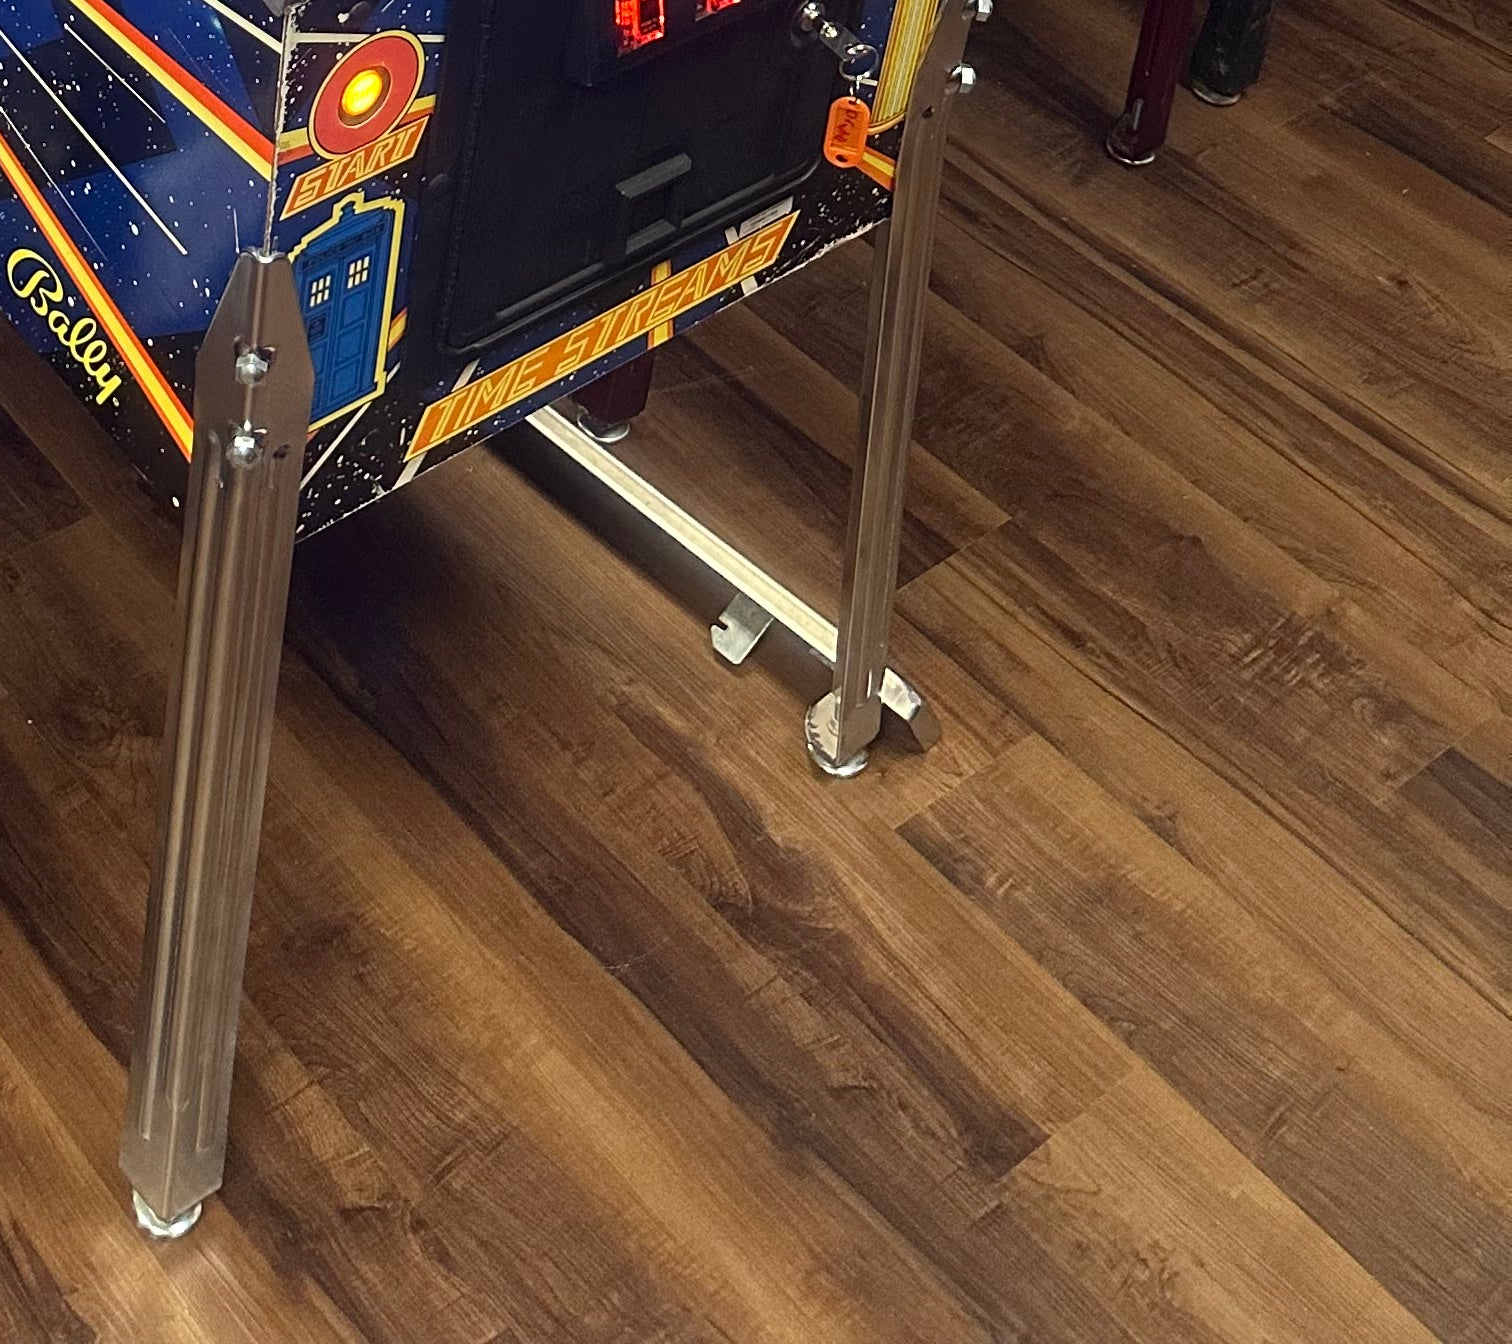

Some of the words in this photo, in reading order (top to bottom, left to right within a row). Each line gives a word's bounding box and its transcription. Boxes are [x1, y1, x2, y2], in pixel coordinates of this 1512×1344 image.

[293, 125, 418, 210] START
[6, 248, 123, 405] Bally
[429, 348, 550, 443] TIME
[554, 221, 784, 378] STREAMS
